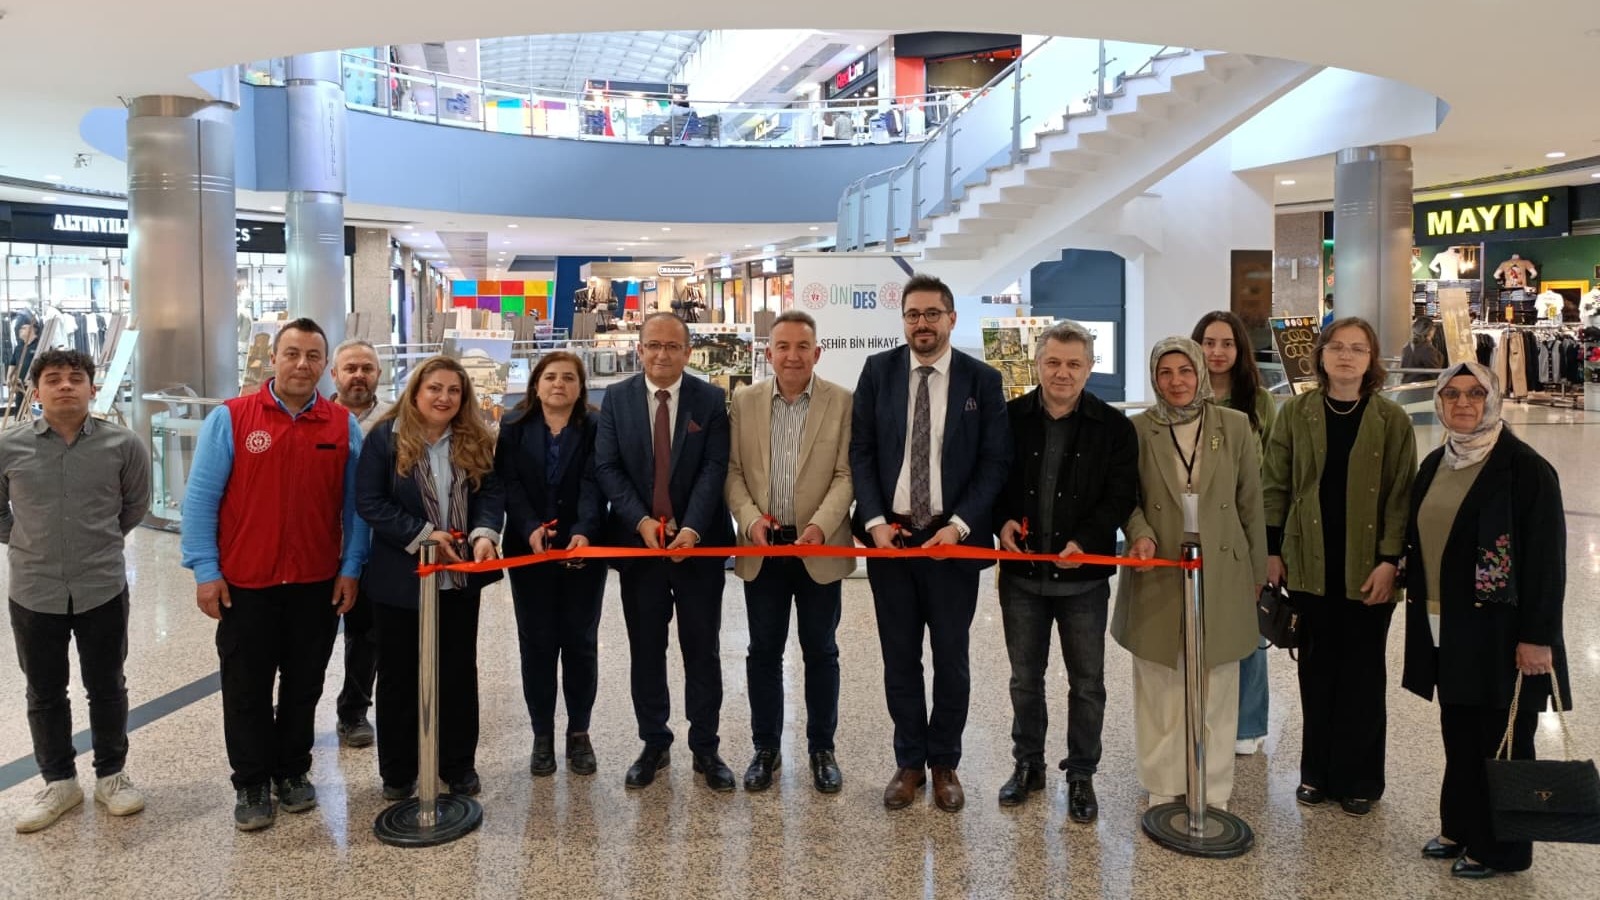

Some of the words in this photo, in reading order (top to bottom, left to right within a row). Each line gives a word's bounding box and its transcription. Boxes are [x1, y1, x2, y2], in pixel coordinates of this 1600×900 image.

[1427, 200, 1544, 236] MAYIN
[820, 336, 847, 351] ŞEHİR
[849, 335, 865, 349] BİN
